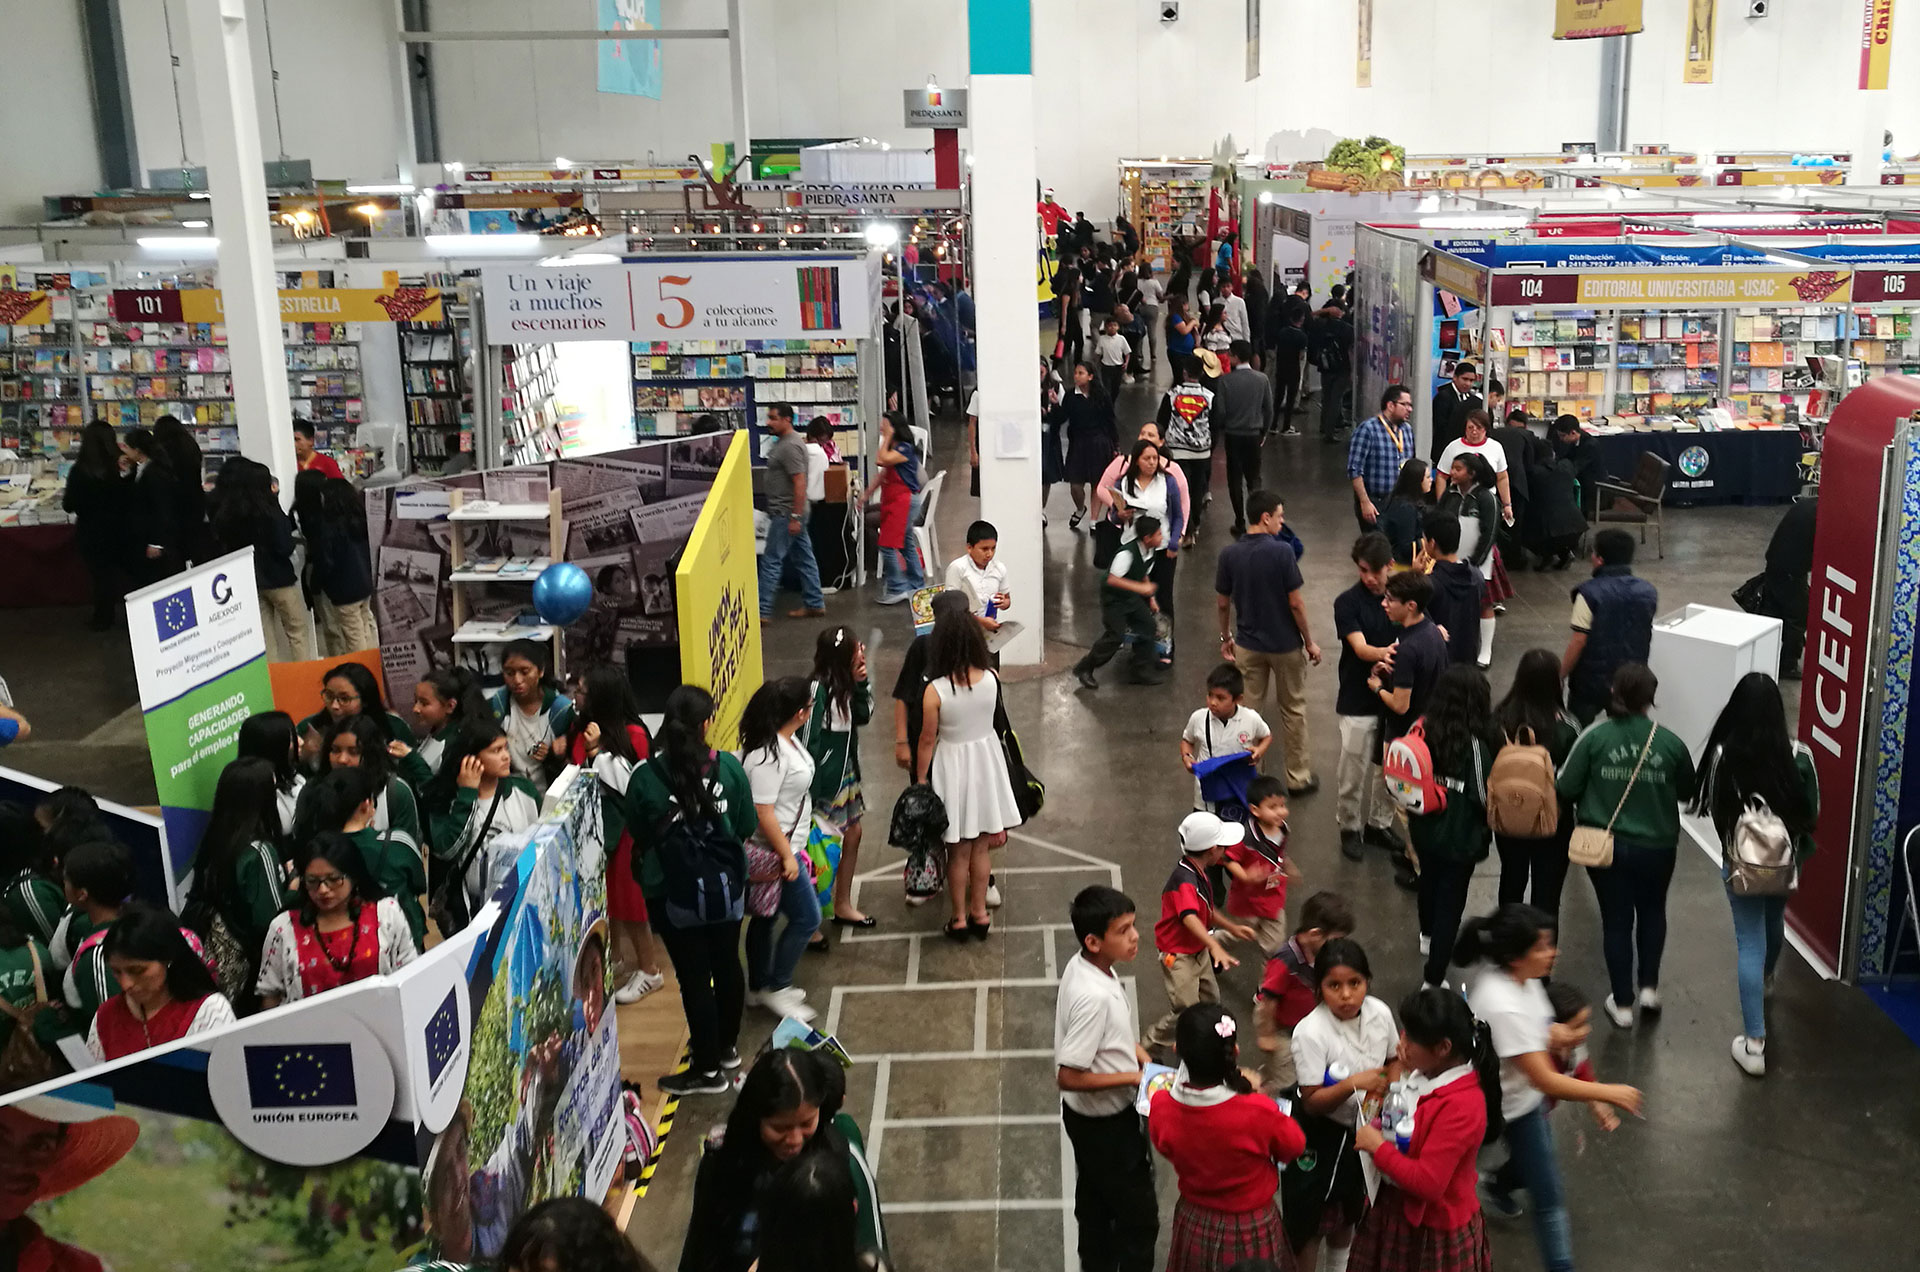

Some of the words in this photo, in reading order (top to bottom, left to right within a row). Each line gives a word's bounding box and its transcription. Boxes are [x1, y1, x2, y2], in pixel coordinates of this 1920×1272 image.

[910, 109, 963, 119] PIEDRASANTA
[805, 191, 896, 207] PIEDRASANTA
[1660, 254, 1691, 262] Edición:
[508, 273, 537, 292] Un
[545, 274, 592, 294] viaje
[1520, 279, 1543, 298] 104
[1584, 279, 1645, 298] EDITORIAL
[1648, 278, 1735, 298] UNIVERSITARIA
[1738, 279, 1780, 297] -USAC-
[1883, 275, 1906, 293] 105
[136, 296, 162, 314] 101
[279, 296, 341, 314] ESTRELLA
[509, 299, 521, 311] a
[529, 292, 603, 311] muchos
[655, 274, 696, 329] 5
[705, 304, 774, 316] colecciones
[511, 313, 606, 332] escenarios
[703, 317, 711, 327] a
[715, 316, 728, 327] tu
[732, 315, 778, 327] alcance
[208, 602, 243, 623] AGEXPORT
[155, 659, 184, 678] Proyecto
[217, 627, 253, 649] Cooperativas
[191, 650, 230, 673] Competitivas
[1811, 564, 1857, 759] ICEFI
[188, 691, 245, 730] GENERANDO
[188, 706, 251, 748] CAPACIDADES
[170, 759, 193, 779] para
[192, 750, 199, 764] el
[199, 736, 232, 759] empleo
[253, 1111, 295, 1124] UNIÓN
[298, 1111, 359, 1123] EUROPEA
